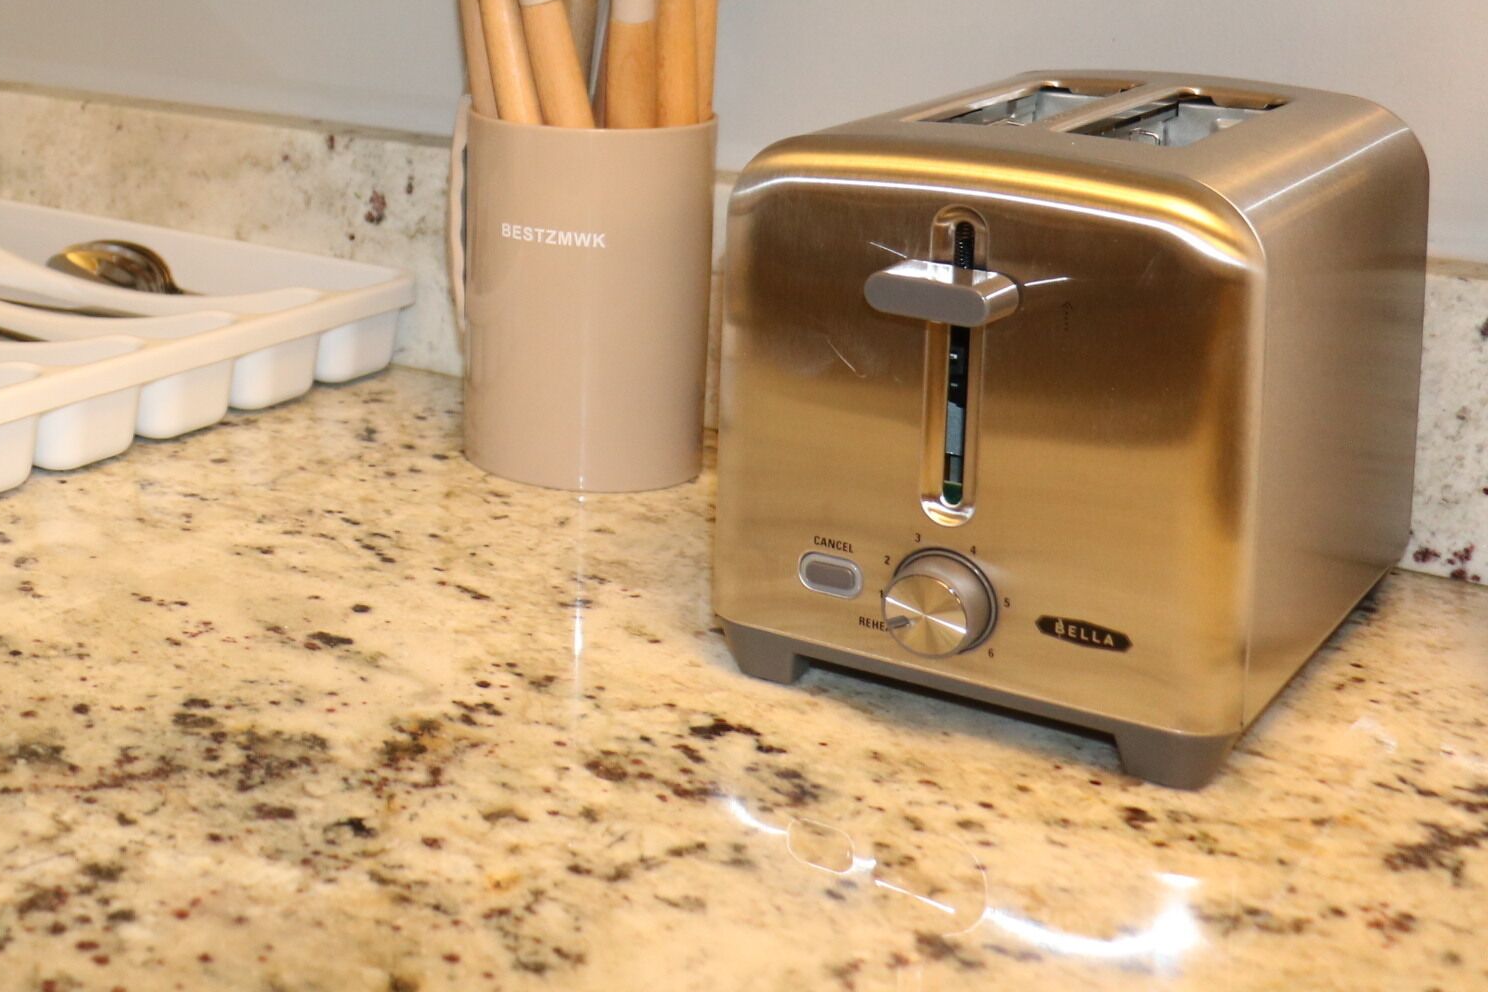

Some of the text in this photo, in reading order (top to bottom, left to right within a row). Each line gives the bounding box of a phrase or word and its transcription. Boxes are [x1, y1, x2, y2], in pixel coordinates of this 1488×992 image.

[501, 222, 606, 249] BESTZMWK
[914, 533, 921, 543] 3
[813, 535, 854, 554] CANCEL
[969, 546, 977, 555] 4
[884, 555, 891, 565] 2
[1004, 597, 1010, 608] 5
[858, 616, 889, 633] REHE
[1054, 619, 1115, 647] BELLA
[988, 648, 995, 659] 6
